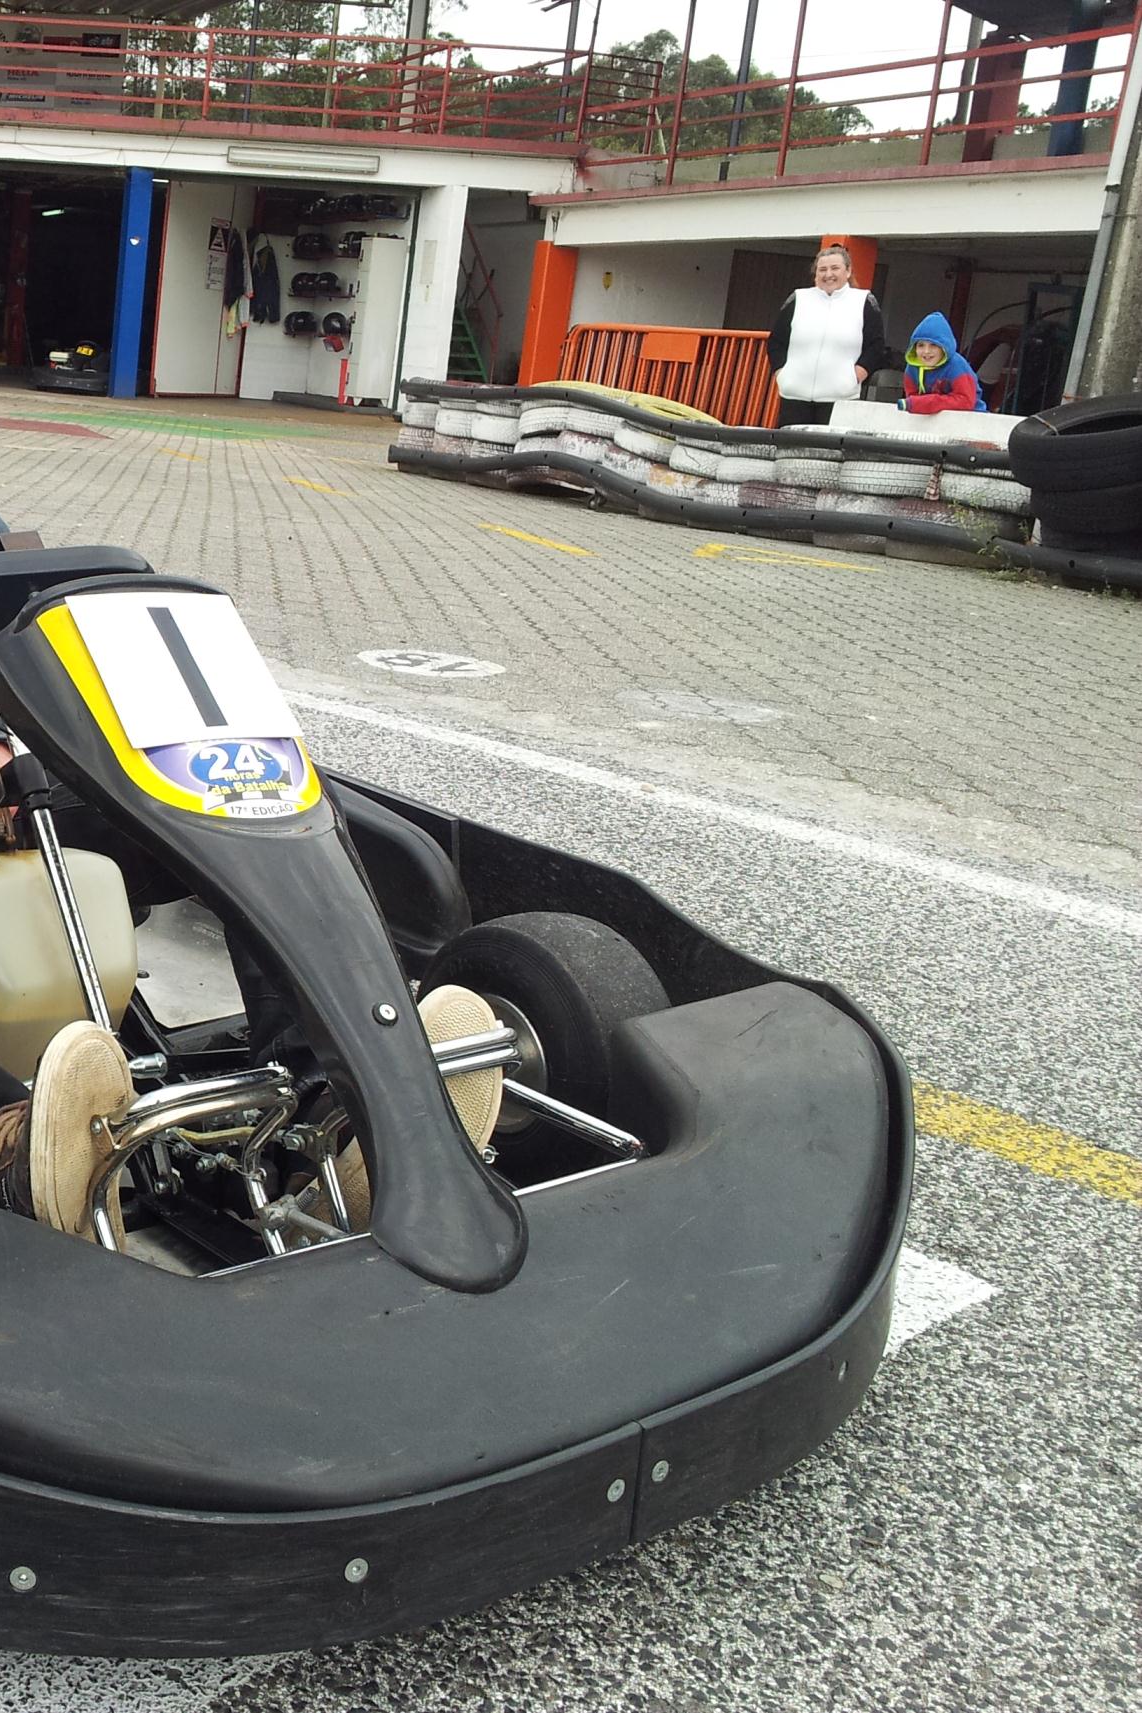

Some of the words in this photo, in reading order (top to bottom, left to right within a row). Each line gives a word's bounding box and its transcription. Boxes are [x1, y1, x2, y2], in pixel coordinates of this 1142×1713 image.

[145, 606, 229, 728] 1
[199, 744, 266, 780] 24
[211, 783, 232, 796] da
[233, 779, 289, 793] Batalha
